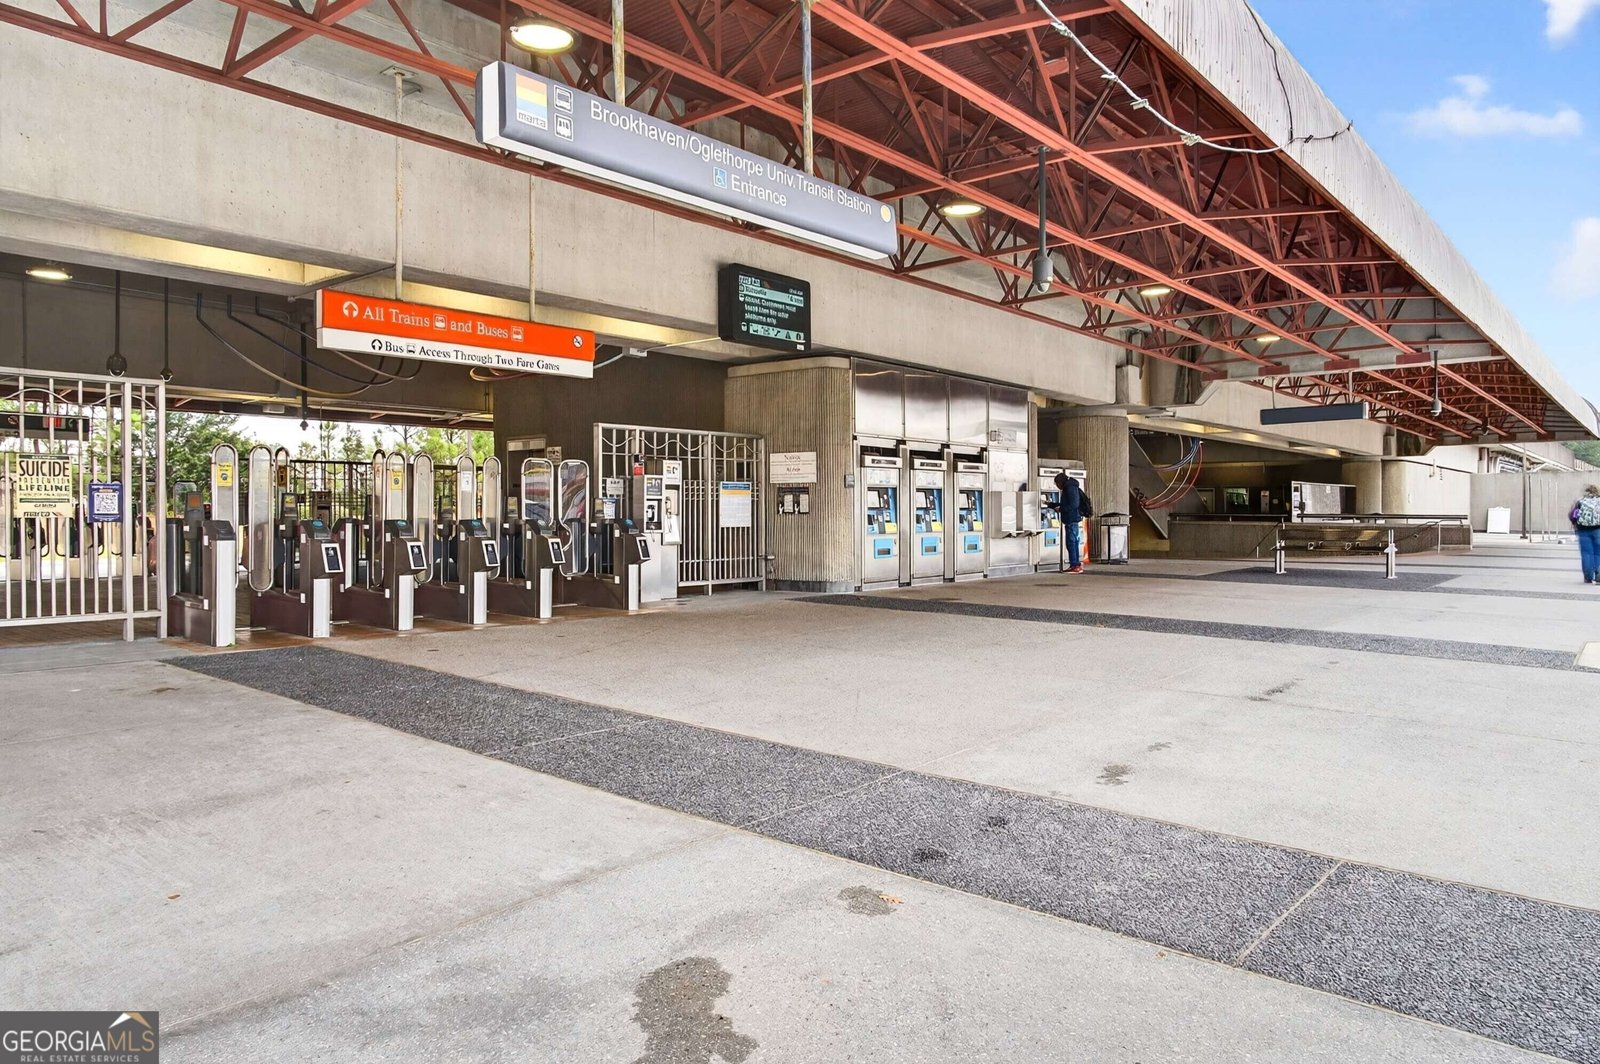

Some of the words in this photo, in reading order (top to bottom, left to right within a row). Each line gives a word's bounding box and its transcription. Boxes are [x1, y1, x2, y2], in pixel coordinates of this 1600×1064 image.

[518, 112, 547, 128] marta
[590, 99, 763, 177] Brookhaven/Oglethorpe
[837, 189, 872, 215] Station
[731, 174, 787, 207] Entrance
[363, 306, 384, 321] All
[389, 308, 430, 327] Trains
[450, 320, 472, 333] and
[477, 321, 508, 339] Buses
[385, 341, 404, 353] Bus
[419, 346, 451, 359] Access
[453, 349, 493, 365] Through
[495, 354, 513, 366] Two
[516, 357, 534, 368] Fare
[536, 359, 560, 371] Gates
[19, 460, 70, 477] SUICIDE
[19, 484, 70, 492] LIFELINE
